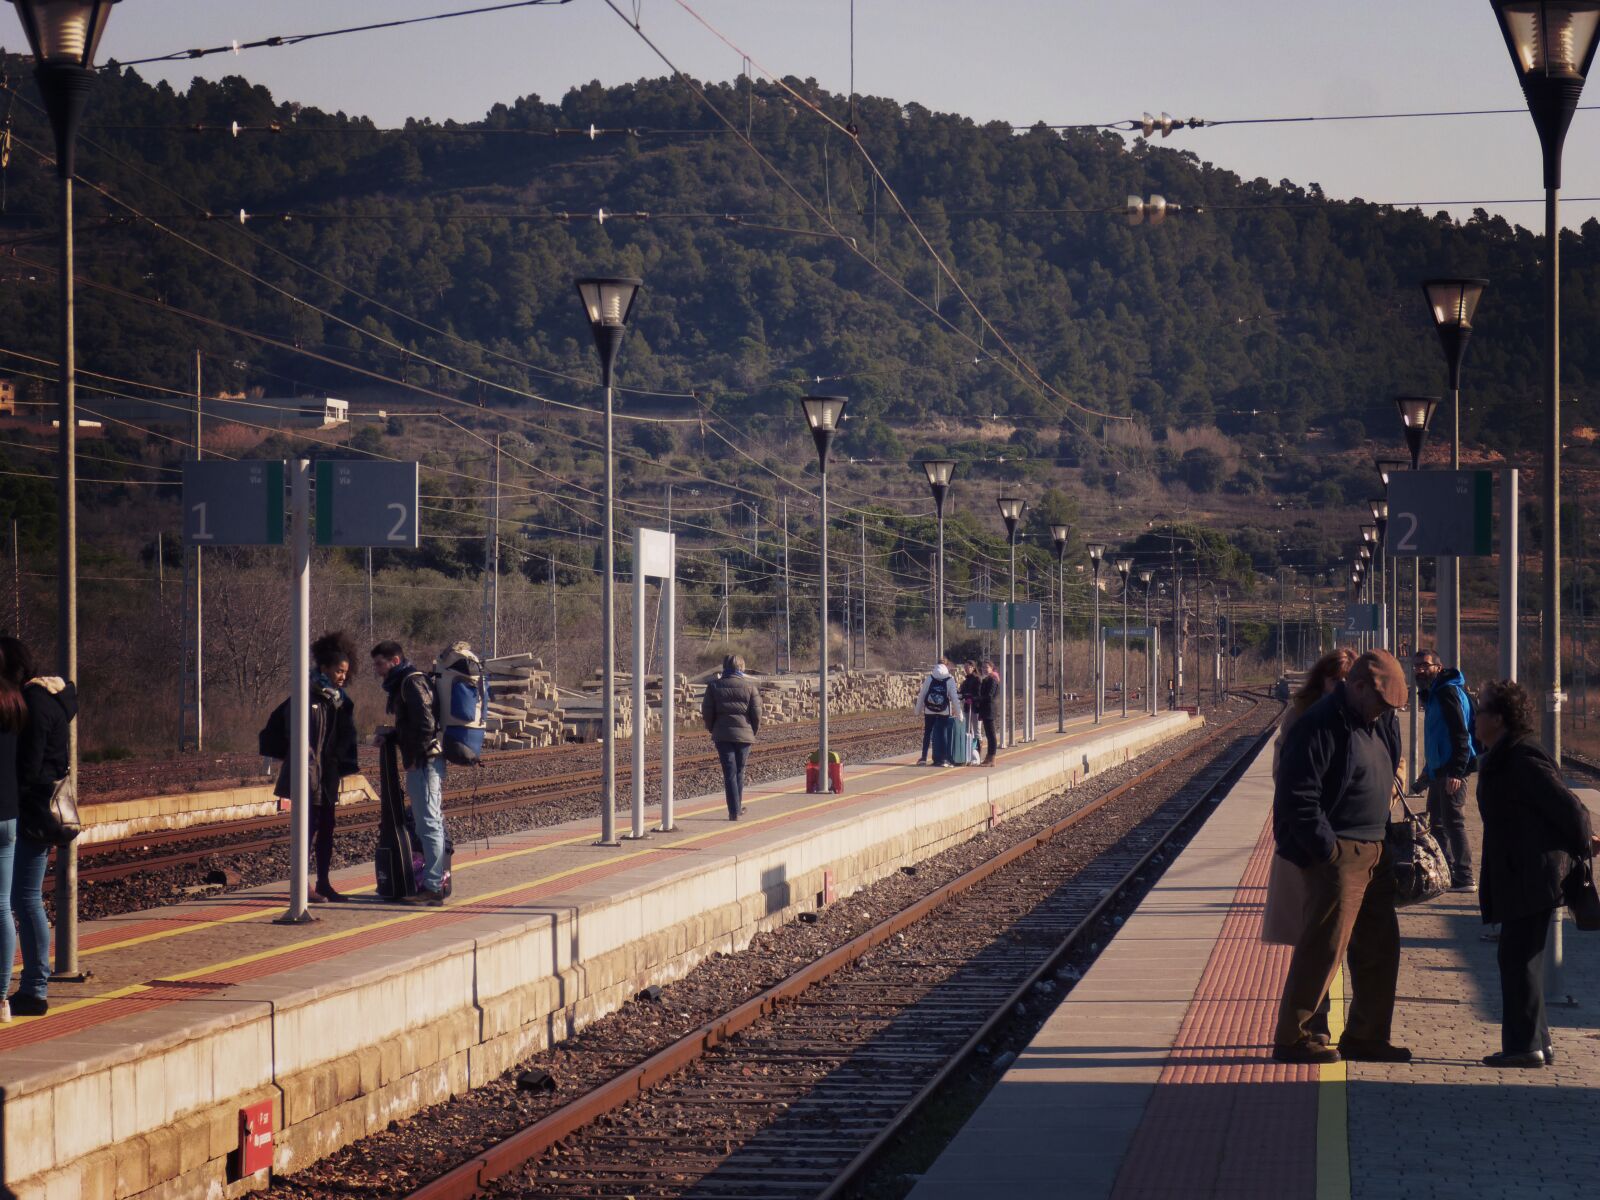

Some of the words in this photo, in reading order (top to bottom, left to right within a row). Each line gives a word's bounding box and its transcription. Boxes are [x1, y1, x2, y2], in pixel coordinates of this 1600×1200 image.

[192, 502, 213, 539] 1
[387, 503, 407, 540] 2
[1397, 512, 1418, 550] 2
[968, 616, 976, 628] 1
[1031, 616, 1038, 628] 2
[1348, 617, 1355, 630] 2
